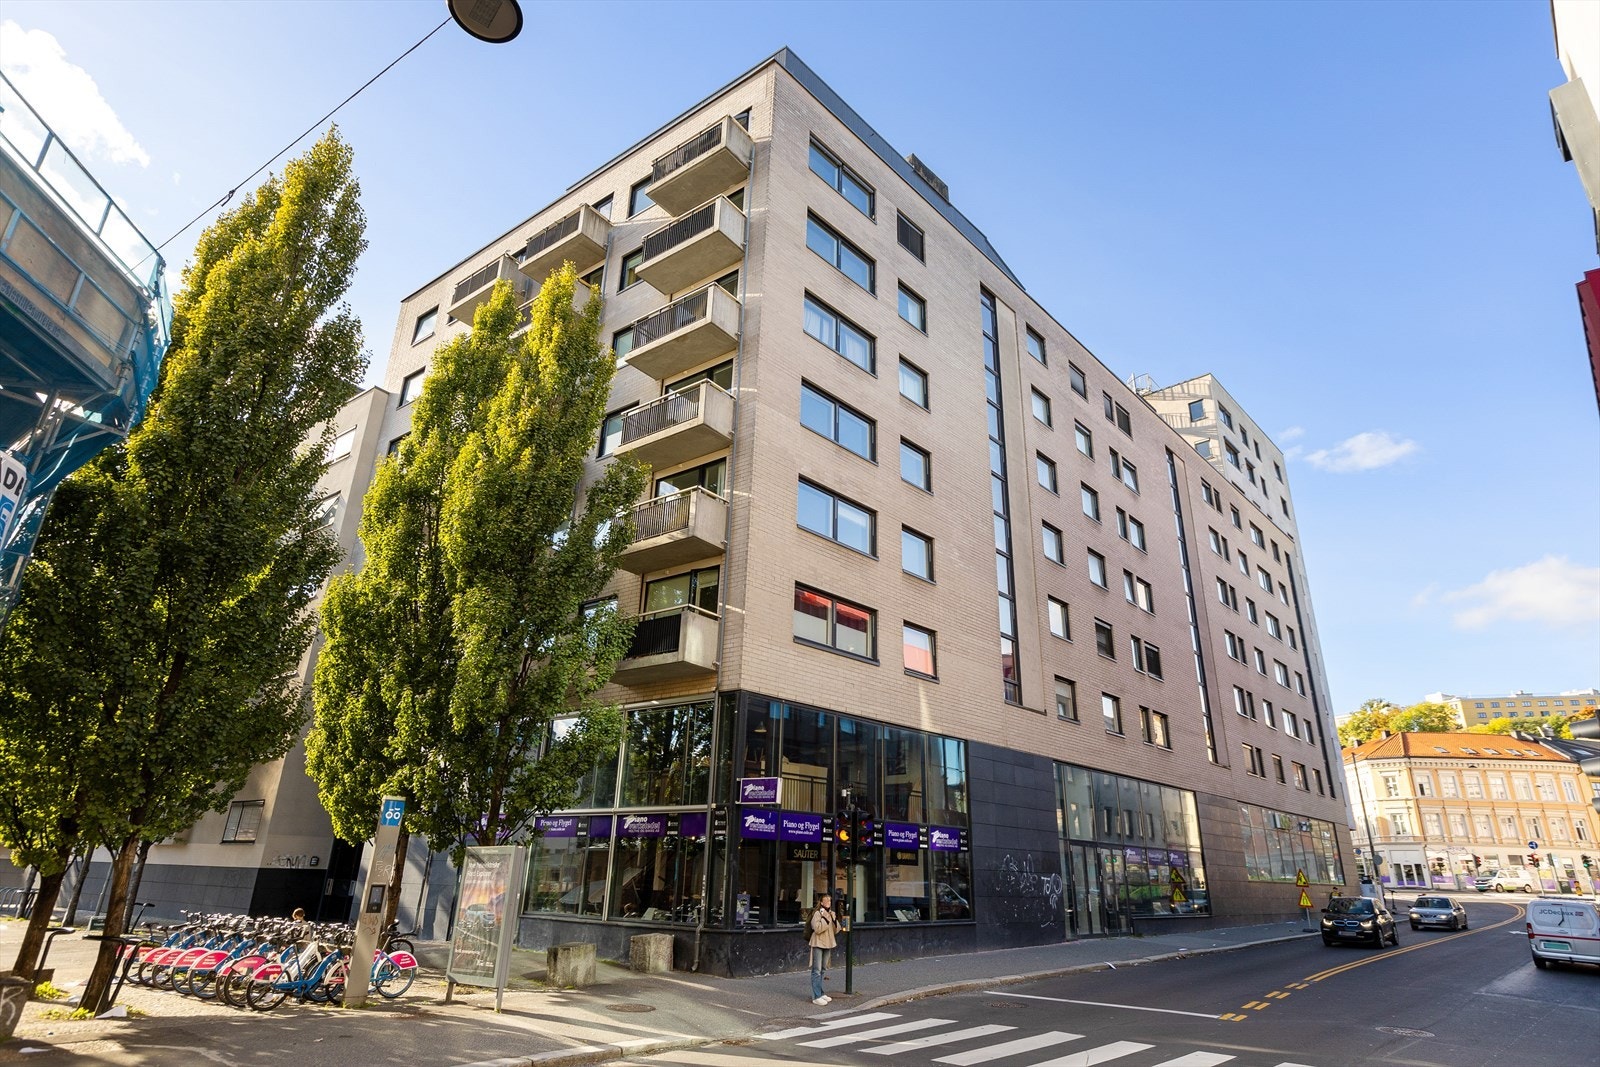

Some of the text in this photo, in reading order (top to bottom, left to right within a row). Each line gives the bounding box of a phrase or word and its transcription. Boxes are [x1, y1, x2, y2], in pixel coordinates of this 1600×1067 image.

[783, 819, 798, 828] Piano
[797, 822, 804, 830] og
[804, 821, 820, 832] Flygel
[888, 829, 900, 837] Piano
[899, 831, 905, 839] og
[905, 830, 918, 840] Flygel
[793, 848, 819, 859] SAUTER
